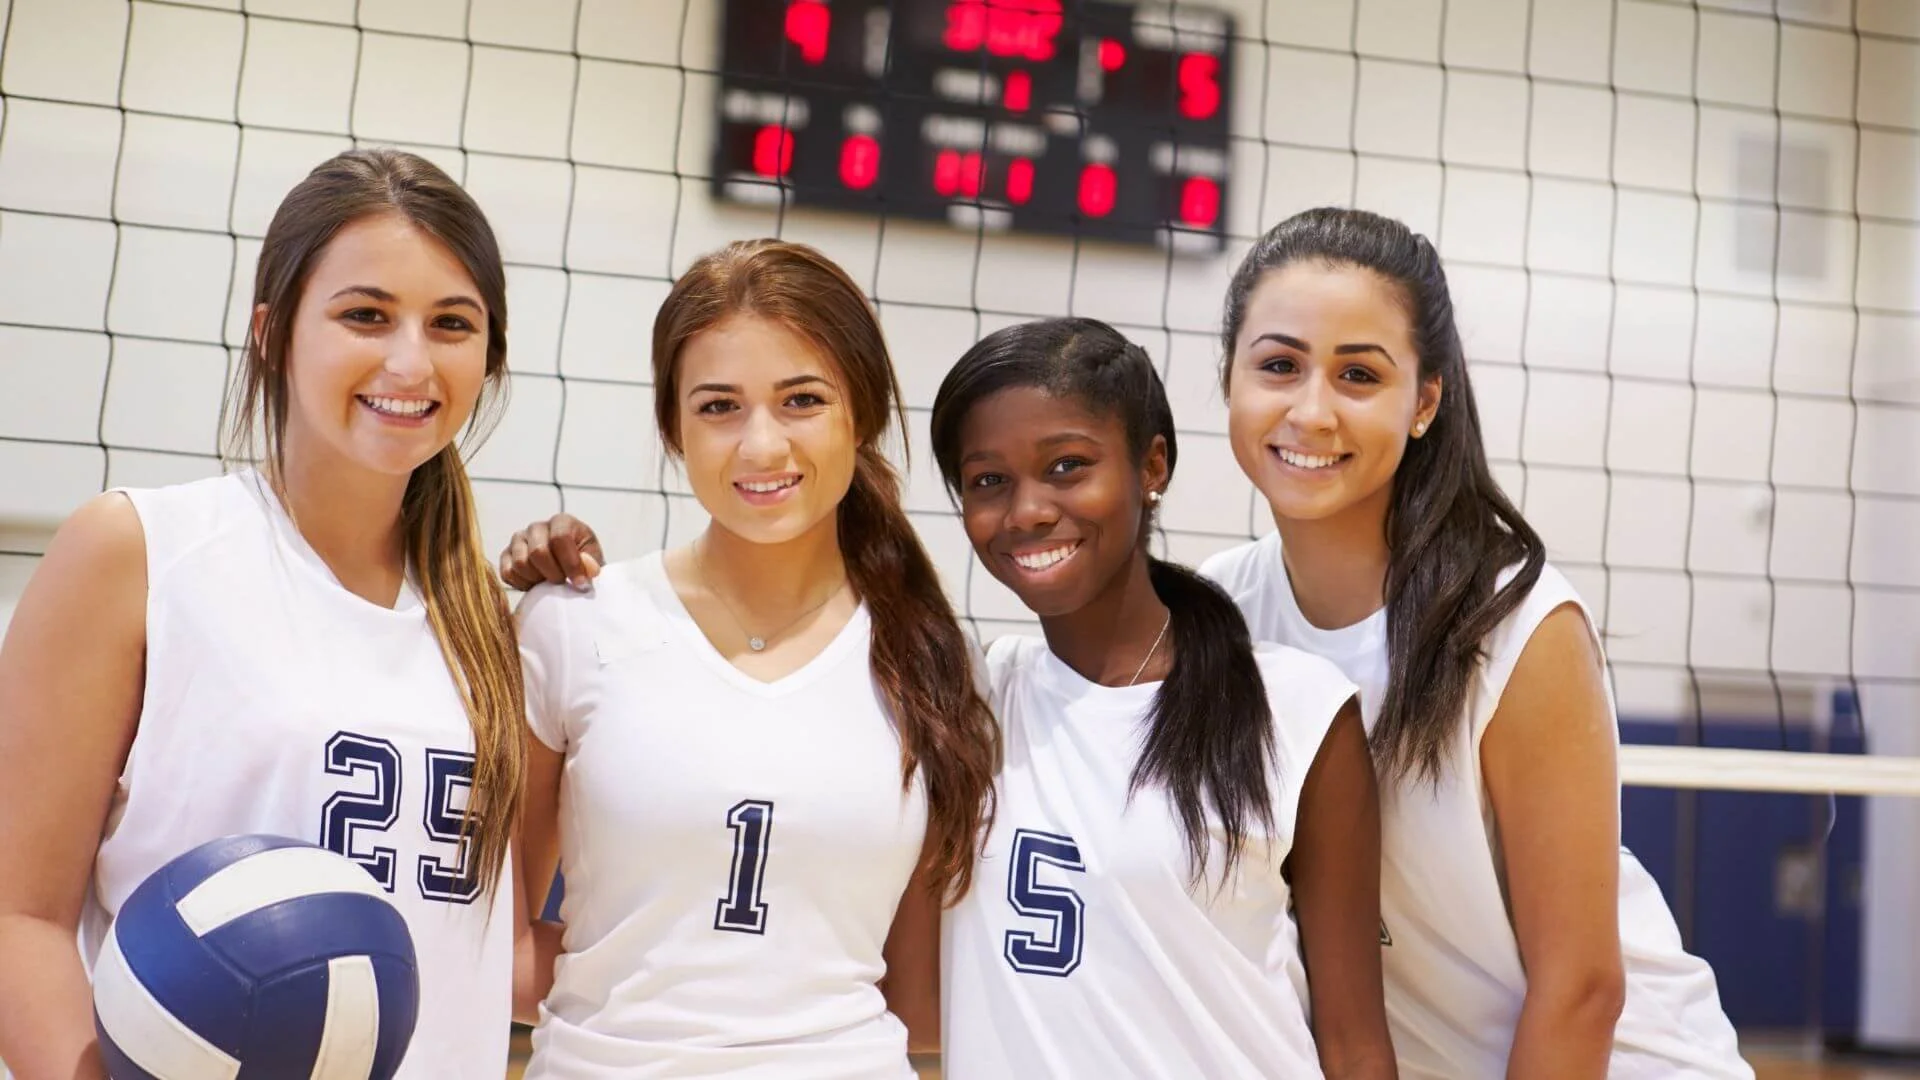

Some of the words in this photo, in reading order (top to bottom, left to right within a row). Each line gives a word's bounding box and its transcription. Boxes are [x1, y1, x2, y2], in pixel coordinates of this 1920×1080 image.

[320, 730, 483, 905] 25
[714, 799, 774, 935] 1
[1003, 828, 1086, 977] 5
